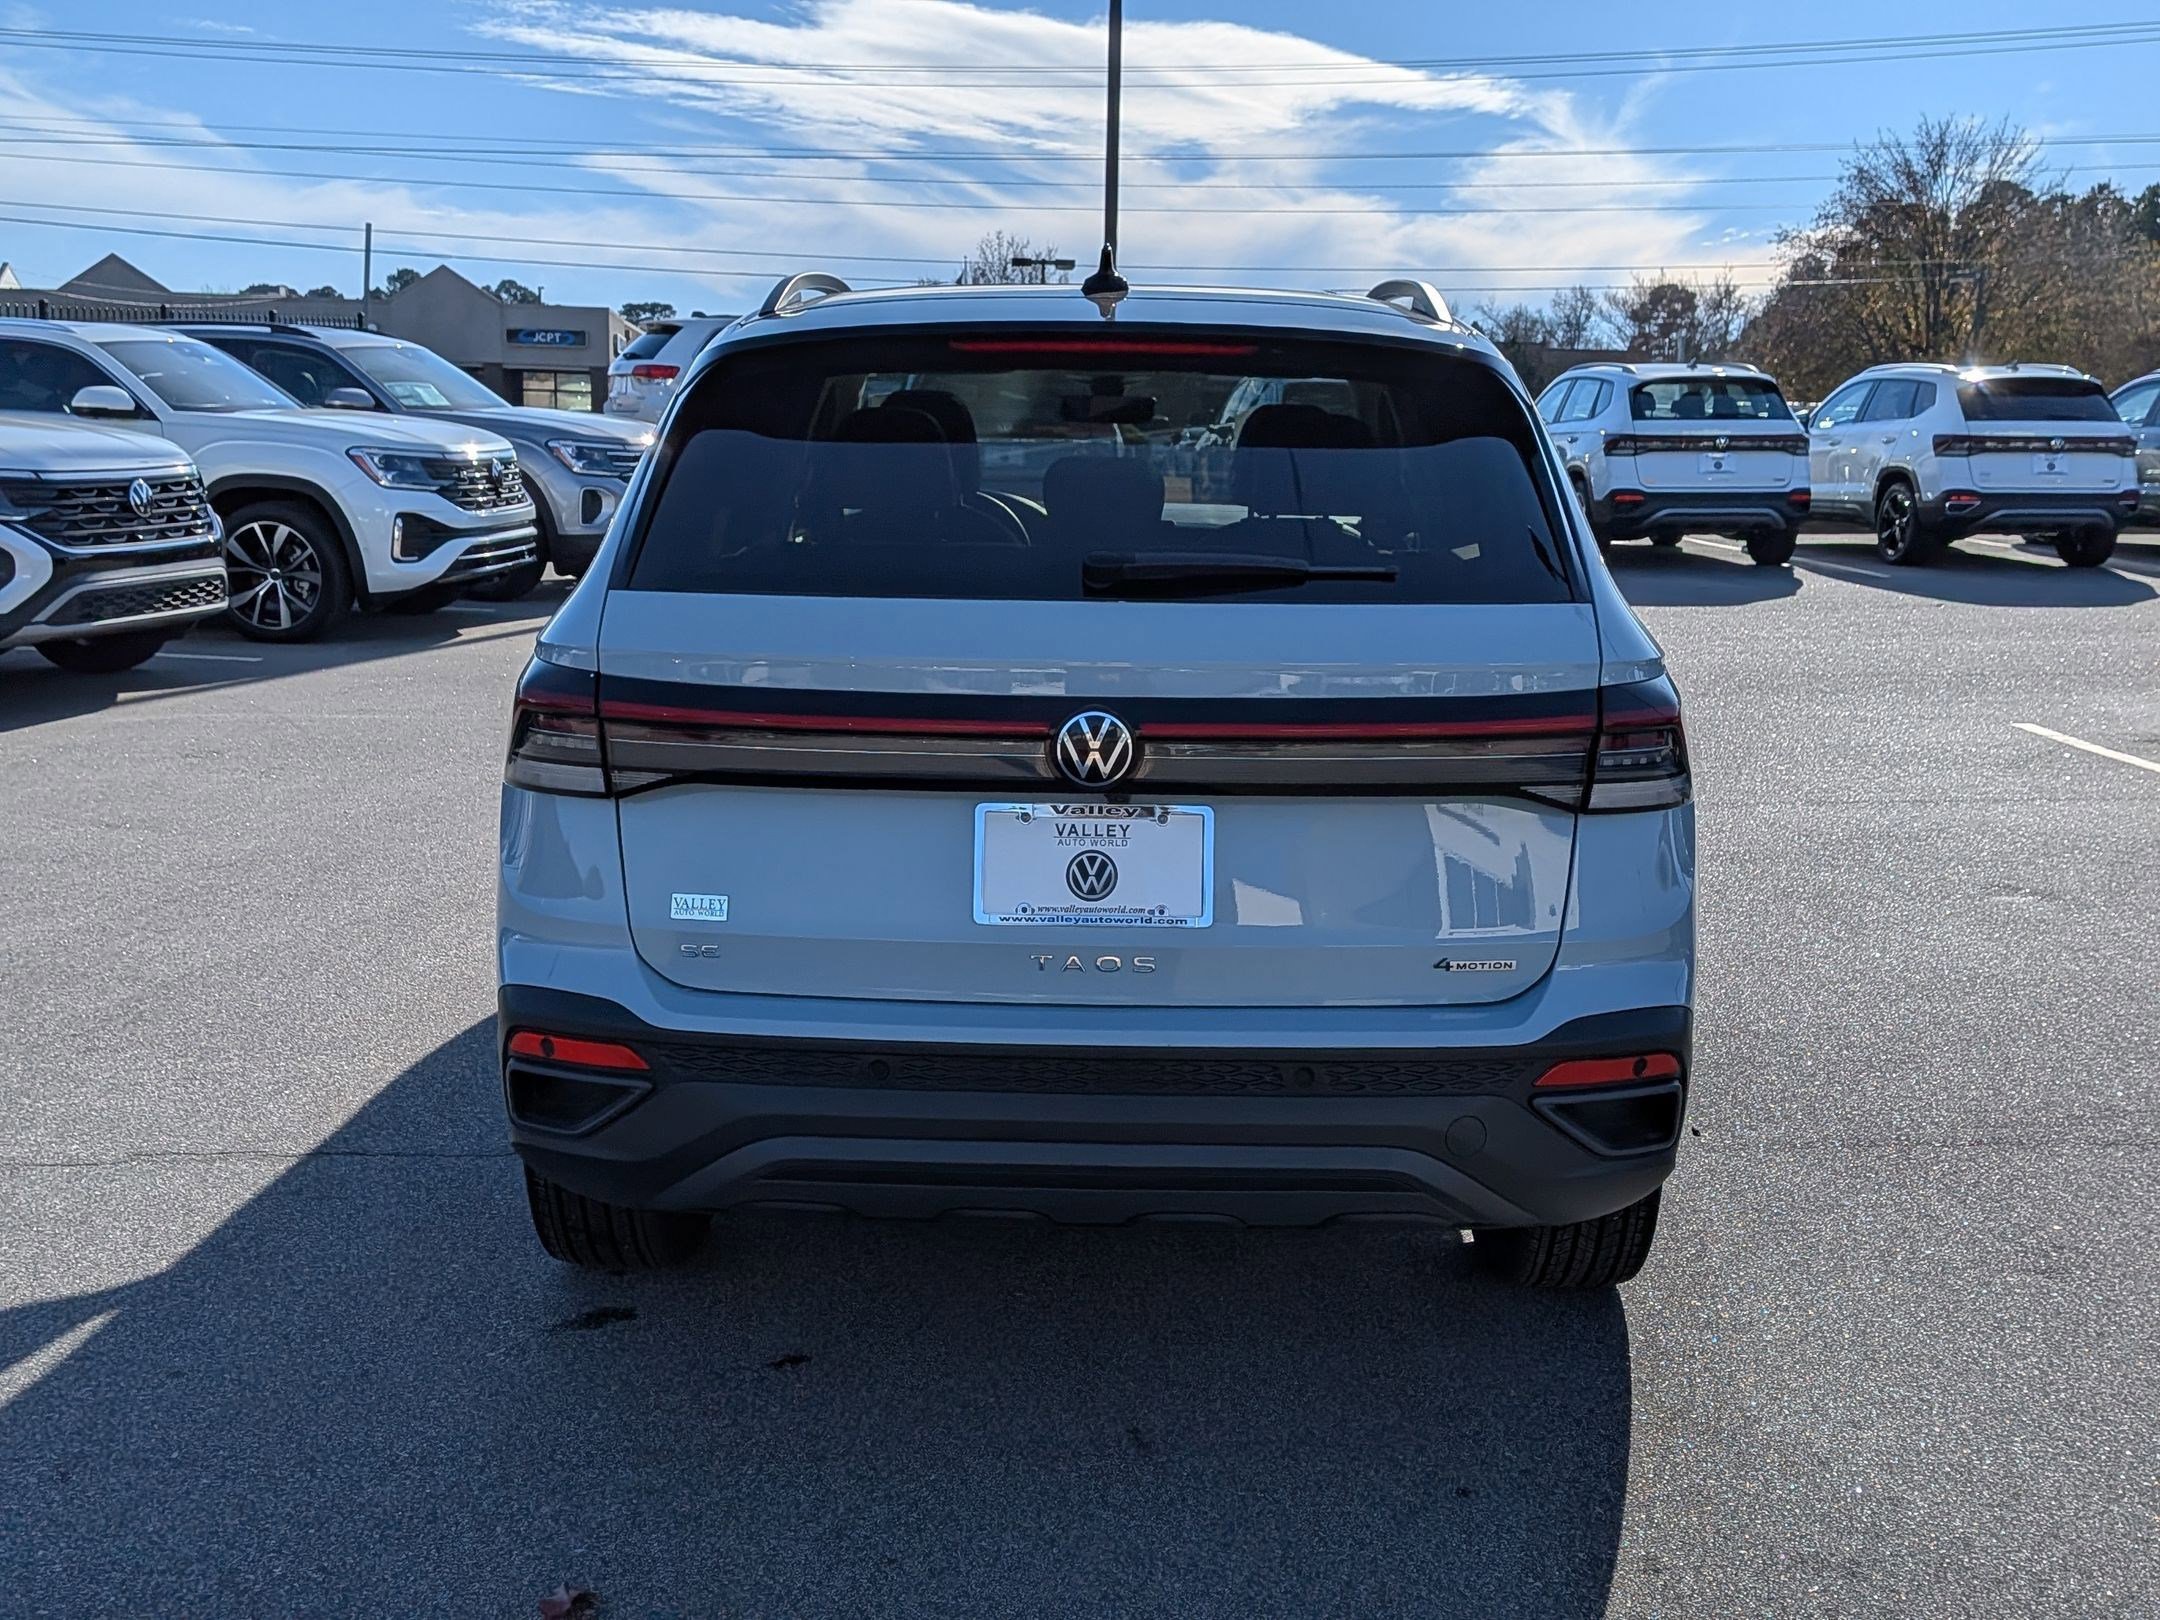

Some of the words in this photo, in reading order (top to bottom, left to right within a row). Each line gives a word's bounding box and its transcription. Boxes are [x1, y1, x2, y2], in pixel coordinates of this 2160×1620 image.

[532, 332, 562, 343] JCPT
[1057, 711, 1133, 787] VW
[1050, 804, 1140, 818] Valley
[1054, 823, 1131, 838] VALLEY
[1057, 838, 1086, 847] AUTO
[1090, 838, 1129, 848] WORLD
[1066, 849, 1118, 902] VW
[673, 896, 727, 910] VALLEY
[1037, 904, 1146, 916] www.valleyautoworld.com
[673, 908, 695, 916] AUTO
[697, 909, 725, 917] WORLD
[998, 914, 1188, 926] www.valleyautoworld.com
[680, 944, 720, 958] SE
[1030, 954, 1157, 974] TAOS
[1433, 957, 1513, 972] 4MOTION
